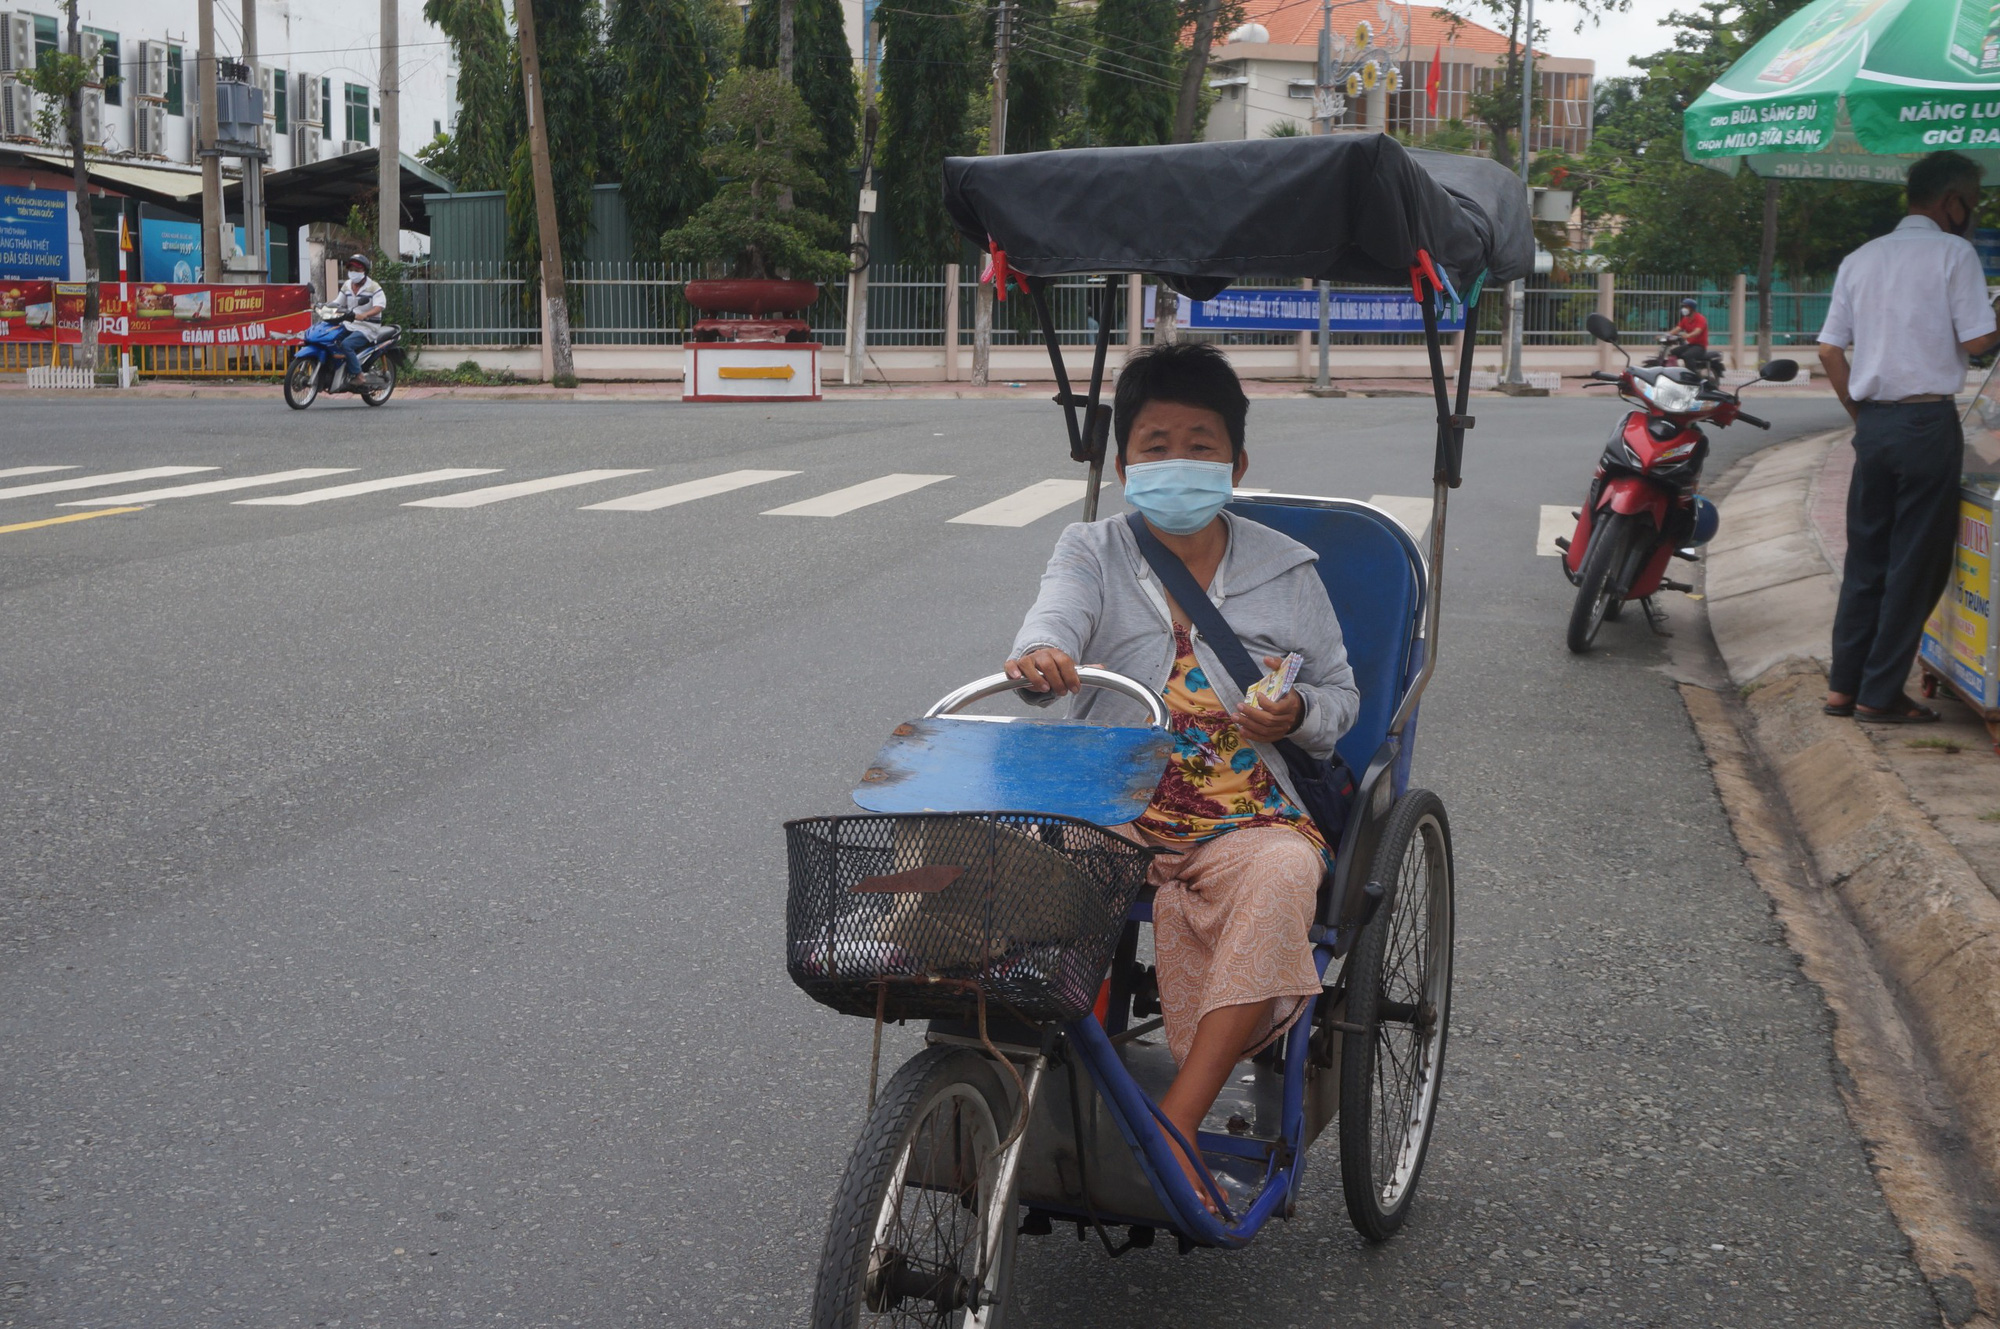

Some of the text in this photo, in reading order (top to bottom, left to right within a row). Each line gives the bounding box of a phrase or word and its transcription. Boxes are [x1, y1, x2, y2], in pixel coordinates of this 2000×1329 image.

[1710, 99, 1818, 127] CHO BỮA SÁNG ĐỦ
[1899, 100, 1968, 122] NĂNG
[1697, 126, 1822, 152] CHỌN MILO BỮA SÁNG
[1922, 125, 1966, 145] GIỜ
[4, 250, 17, 264] ĐÃI
[18, 252, 34, 265] SIÊU
[218, 297, 262, 313] 10 TRIỆU
[58, 318, 80, 329] CÙNG
[130, 320, 151, 331] 2021
[182, 322, 266, 343] GIẢM GIÁ LỚN
